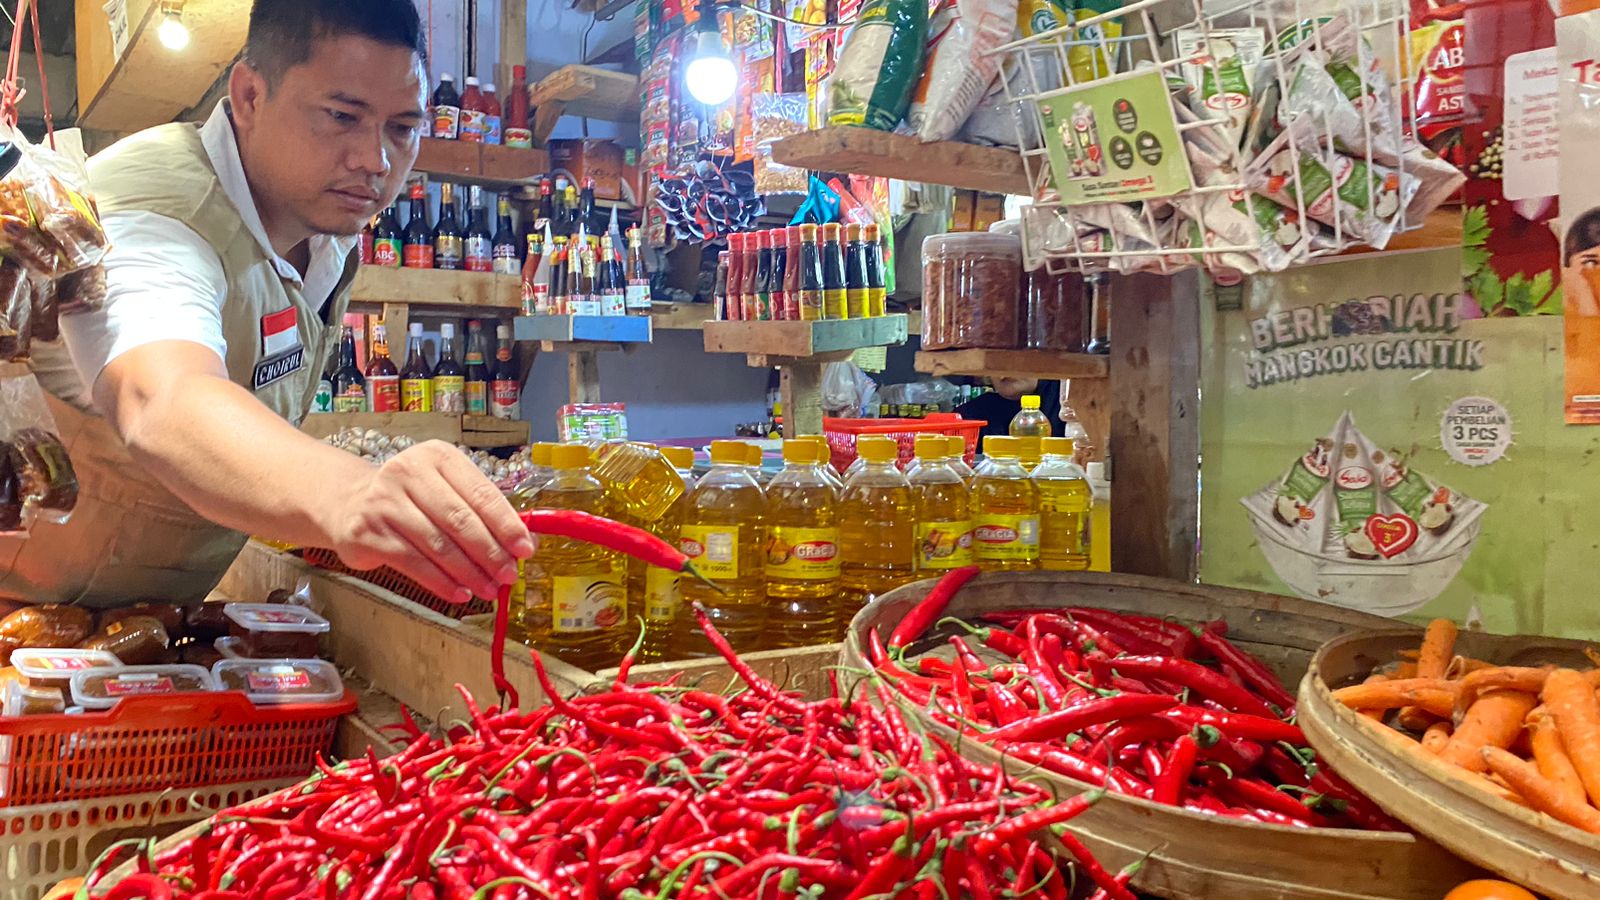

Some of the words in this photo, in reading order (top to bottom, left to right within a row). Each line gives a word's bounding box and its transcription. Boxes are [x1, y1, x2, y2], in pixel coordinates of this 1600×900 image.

[374, 250, 395, 261] ABC
[259, 352, 300, 384] CHOIRUL
[1245, 343, 1367, 388] MANGKOK
[1374, 340, 1484, 369] CANTIK
[1457, 405, 1495, 415] SETIAP
[1446, 415, 1506, 425] PEMBELIAN
[1453, 425, 1464, 440] 3
[1468, 427, 1498, 441] PCS
